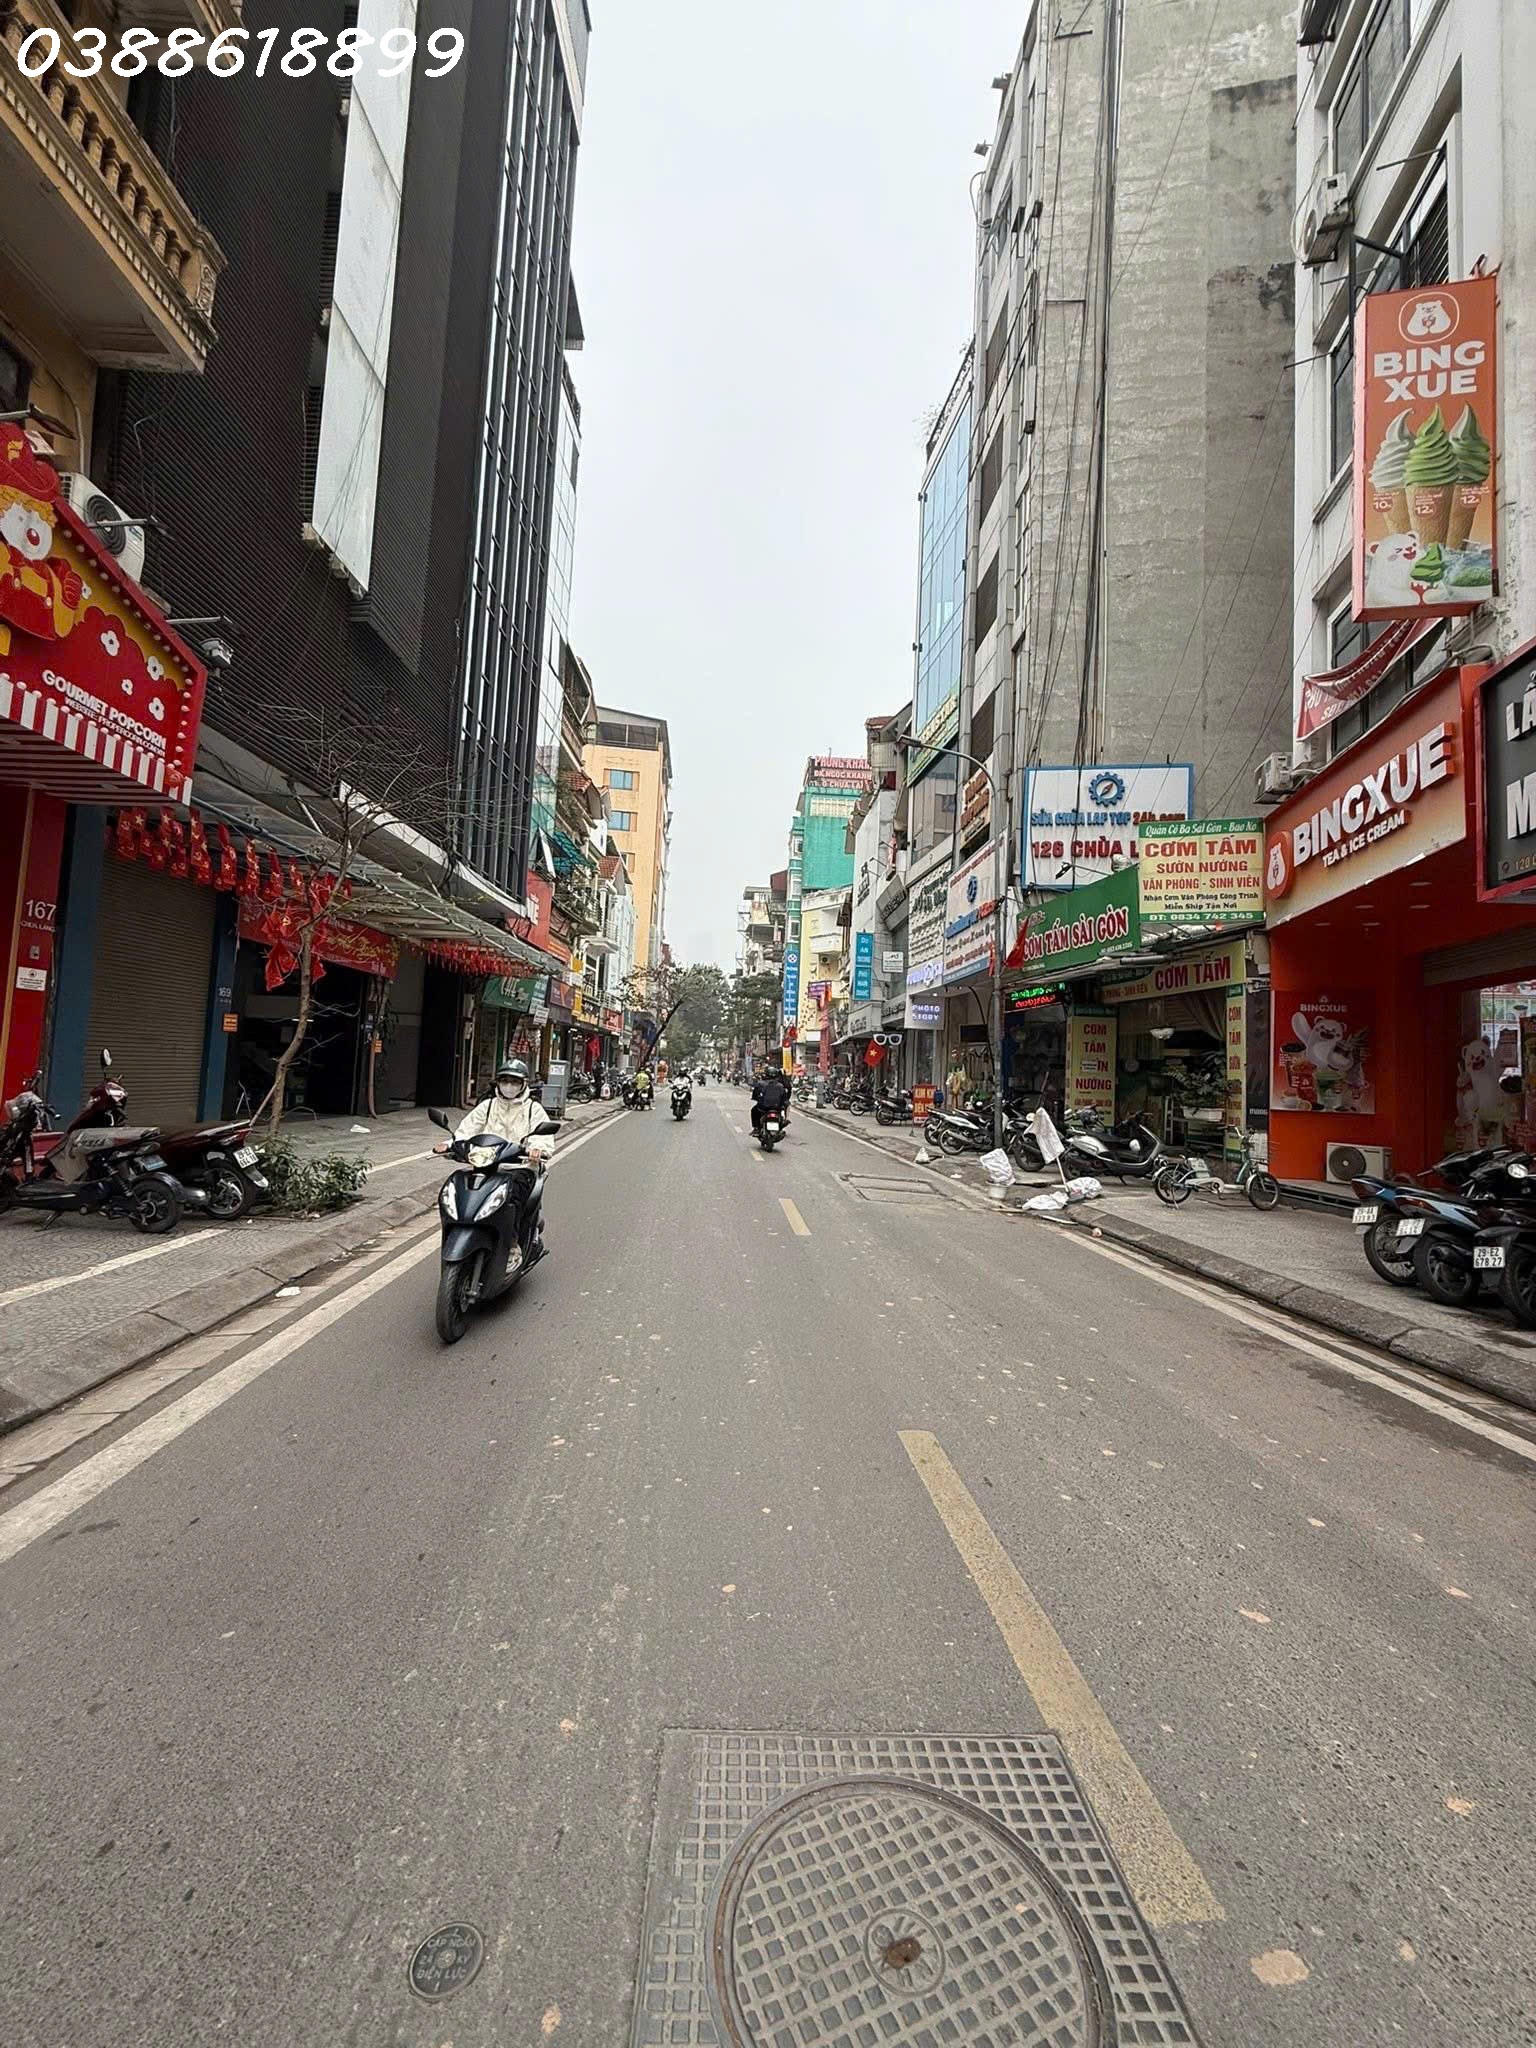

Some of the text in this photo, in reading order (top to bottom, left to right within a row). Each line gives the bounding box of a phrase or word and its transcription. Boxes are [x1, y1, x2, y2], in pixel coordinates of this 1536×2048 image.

[1374, 340, 1486, 377] BING
[1384, 368, 1477, 403] XUE
[42, 669, 166, 751] GOURMET POPCORN
[1293, 722, 1450, 868] BINGXUE
[1206, 821, 1222, 833] Gòn
[1228, 821, 1246, 832] Bao
[1032, 840, 1064, 859] 126
[1071, 835, 1123, 859] CHÙA
[1144, 834, 1257, 858] CƠM TẤM
[1322, 849, 1339, 868] TEA
[1349, 833, 1365, 854] ICE
[1367, 810, 1406, 843] CREAM
[1156, 858, 1248, 874] SƯỜN NƯỚNG
[1143, 877, 1163, 890] VĂN
[1165, 876, 1199, 890] PHÒNG
[1209, 877, 1233, 889] SINH
[1236, 874, 1260, 887] VIÊN
[1185, 901, 1204, 910] Ship
[1196, 892, 1218, 901] Phòng
[26, 899, 57, 921] 167
[1204, 912, 1227, 920] 742
[1230, 912, 1254, 920] 345
[1070, 912, 1096, 949] SÀI
[1095, 903, 1130, 943] GÒN
[1155, 962, 1188, 991] CƠM
[1192, 951, 1232, 985] TẤM
[911, 1004, 940, 1014] PHOTO
[1300, 1003, 1349, 1013] BINGXUE
